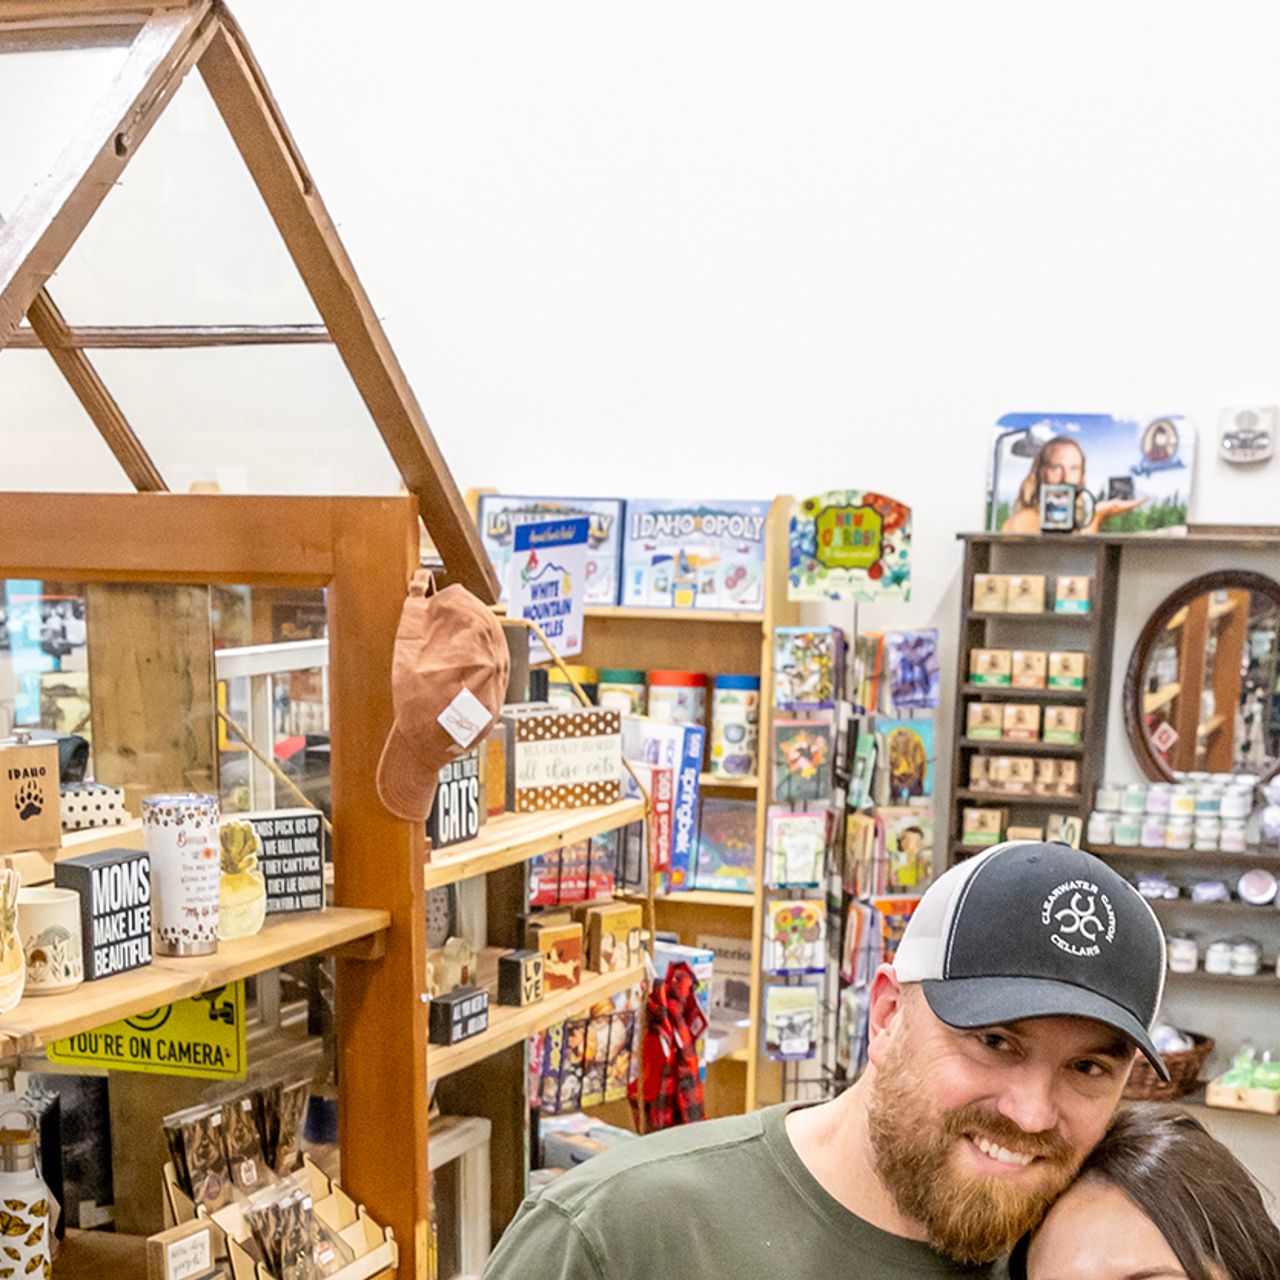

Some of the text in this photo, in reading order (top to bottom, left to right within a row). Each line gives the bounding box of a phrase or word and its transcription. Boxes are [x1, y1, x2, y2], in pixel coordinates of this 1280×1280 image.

[632, 514, 695, 538] IDAHO
[702, 514, 766, 540] OPOLY
[530, 580, 559, 601] WHITE
[523, 598, 572, 622] MOUNTAIN
[8, 766, 46, 780] IDAHO
[519, 756, 614, 780] all these cats
[439, 777, 478, 843] CATS
[274, 818, 295, 834] PICK
[295, 817, 307, 833] US
[307, 817, 319, 833] UP
[92, 858, 150, 915] MOMS
[1041, 880, 1099, 924] CLEARWATER
[93, 906, 152, 947] MAKE LIFE
[95, 935, 152, 977] BEAUTIFUL
[1050, 934, 1101, 957] CELLARS
[70, 1031, 224, 1067] YOU'RE ON CAMERA
